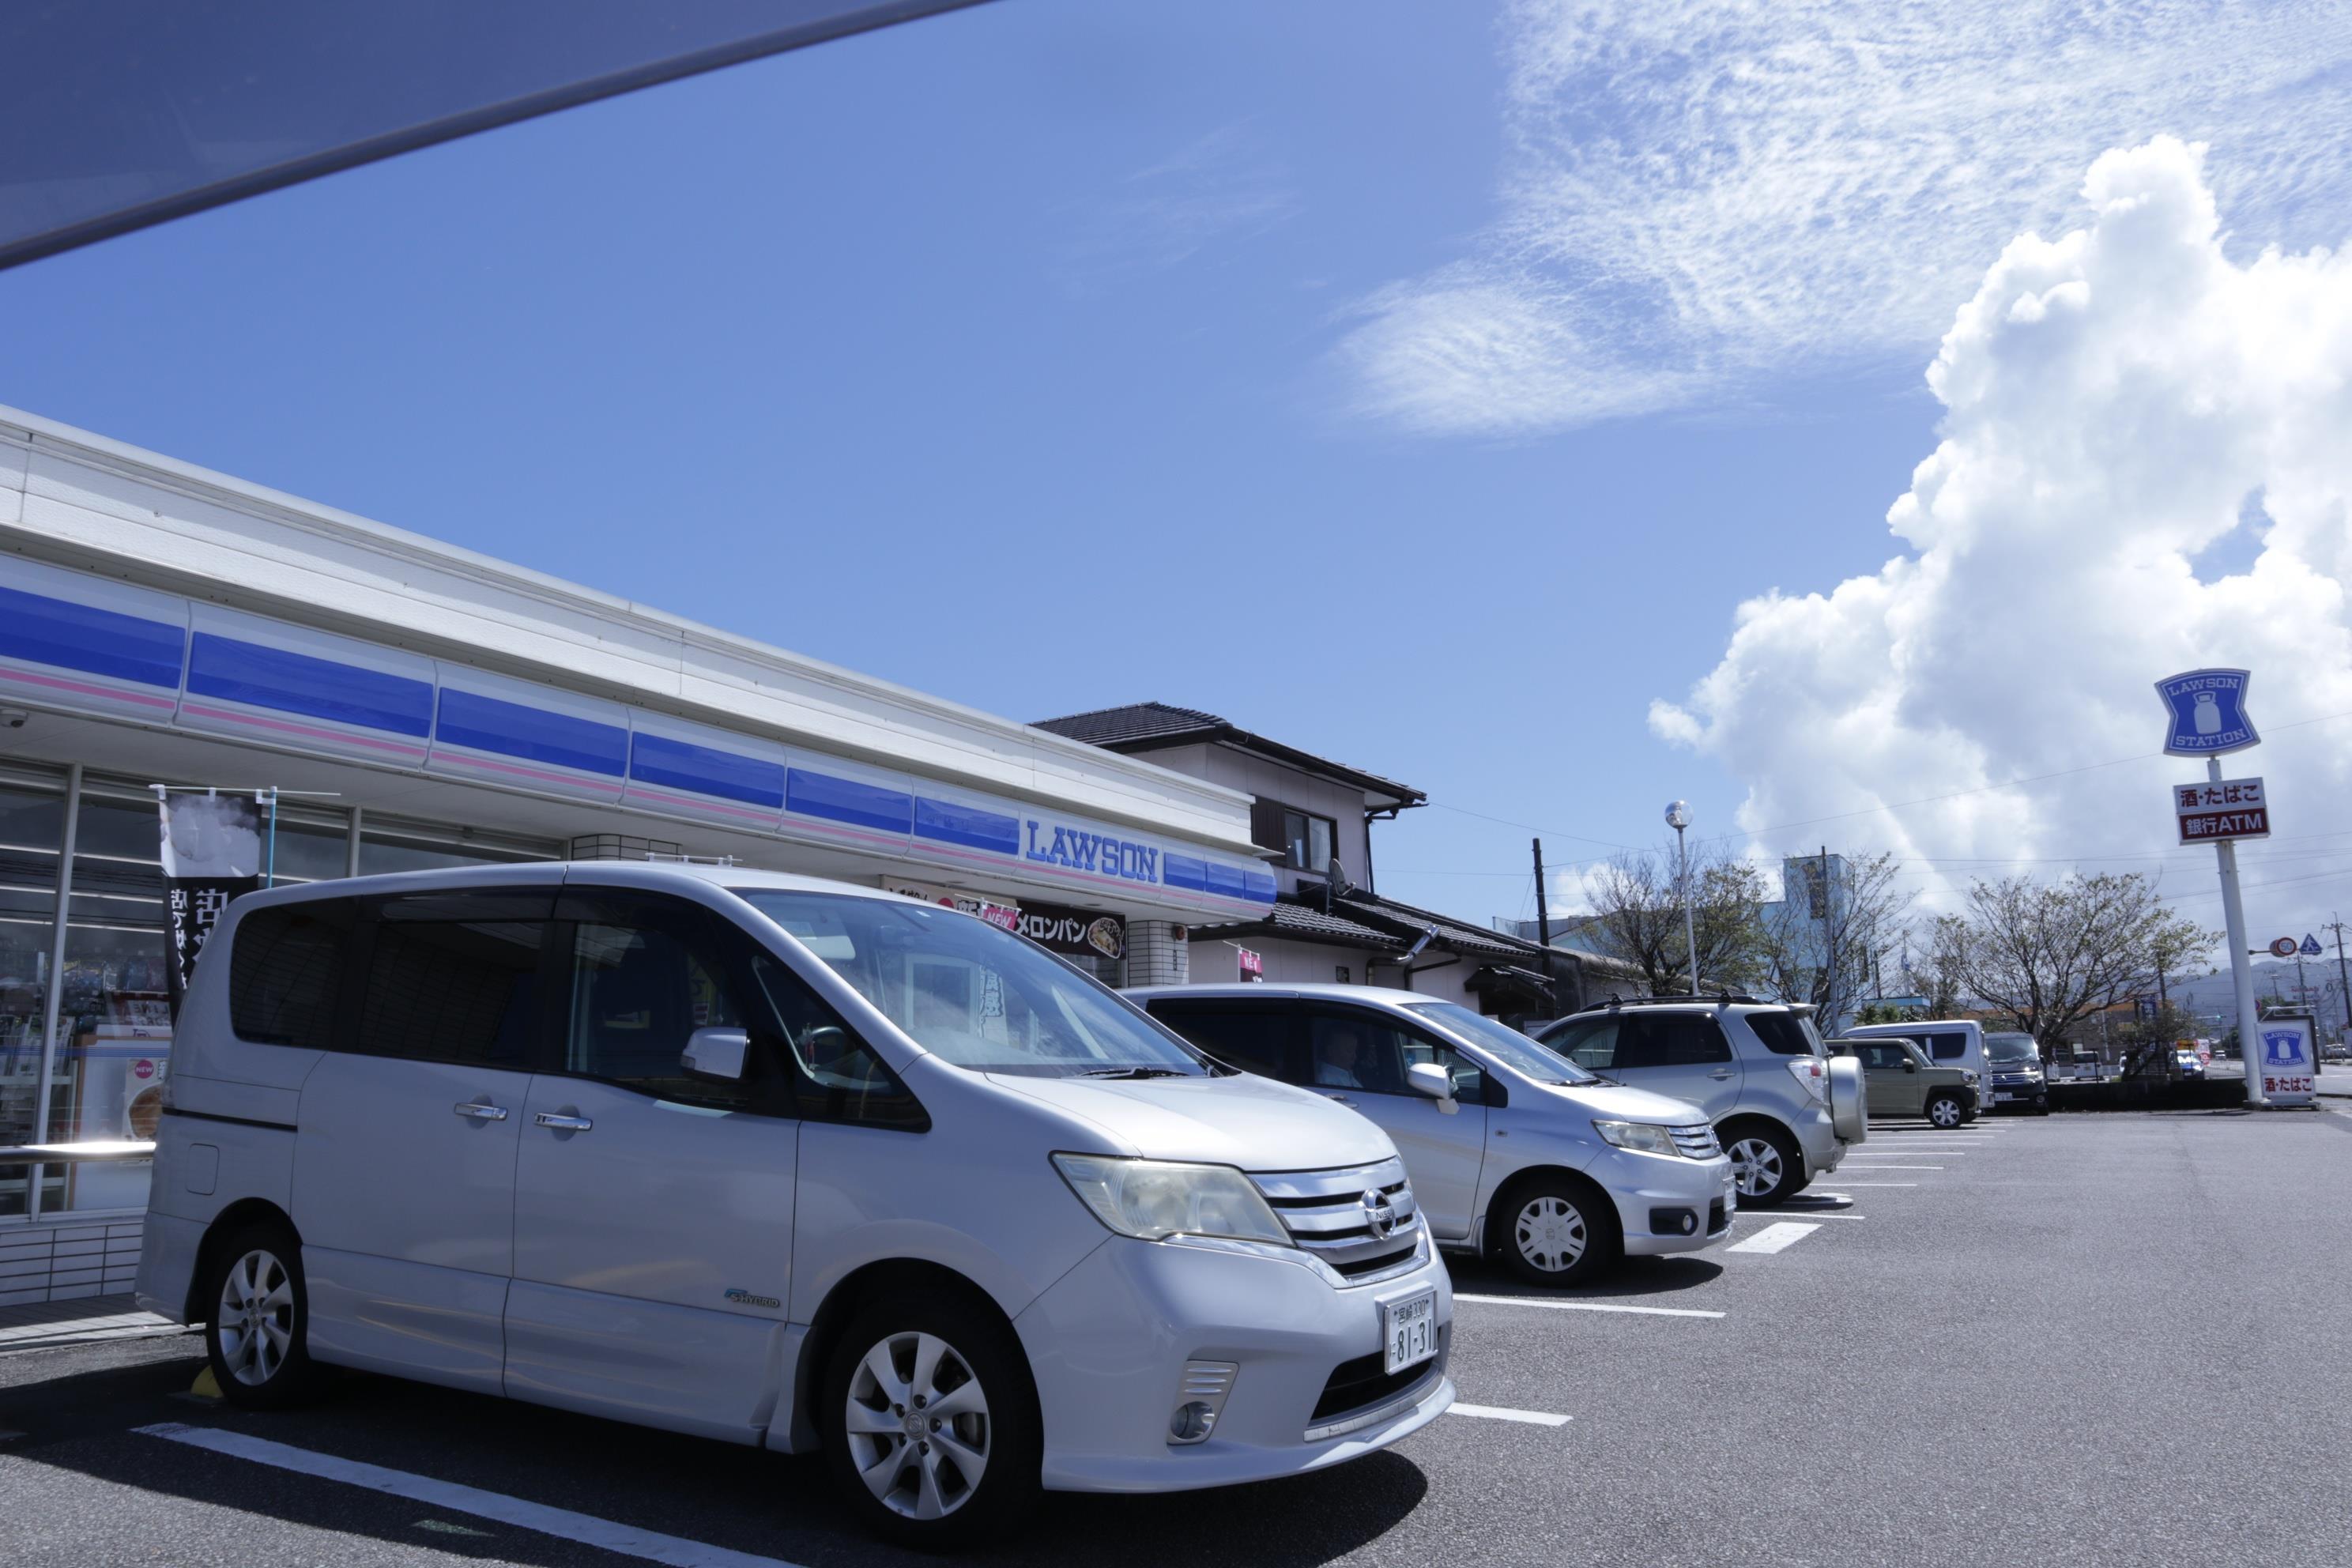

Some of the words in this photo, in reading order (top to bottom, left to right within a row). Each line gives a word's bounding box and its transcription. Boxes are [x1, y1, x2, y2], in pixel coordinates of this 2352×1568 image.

[2168, 677, 2239, 696] LAWSON
[2176, 728, 2246, 747] STATION
[2180, 785, 2260, 807] 酒・たばこ
[2186, 813, 2263, 835] 銀行ATM
[1027, 820, 1158, 883] LAWSON
[1016, 914, 1086, 944] メロンパン
[2280, 941, 2292, 951] 50
[2264, 1031, 2300, 1040] LAWSON
[2268, 1057, 2304, 1065] STATION
[2264, 1077, 2312, 1092] 酒・たばこ
[1397, 1318, 1431, 1363] 81-31
